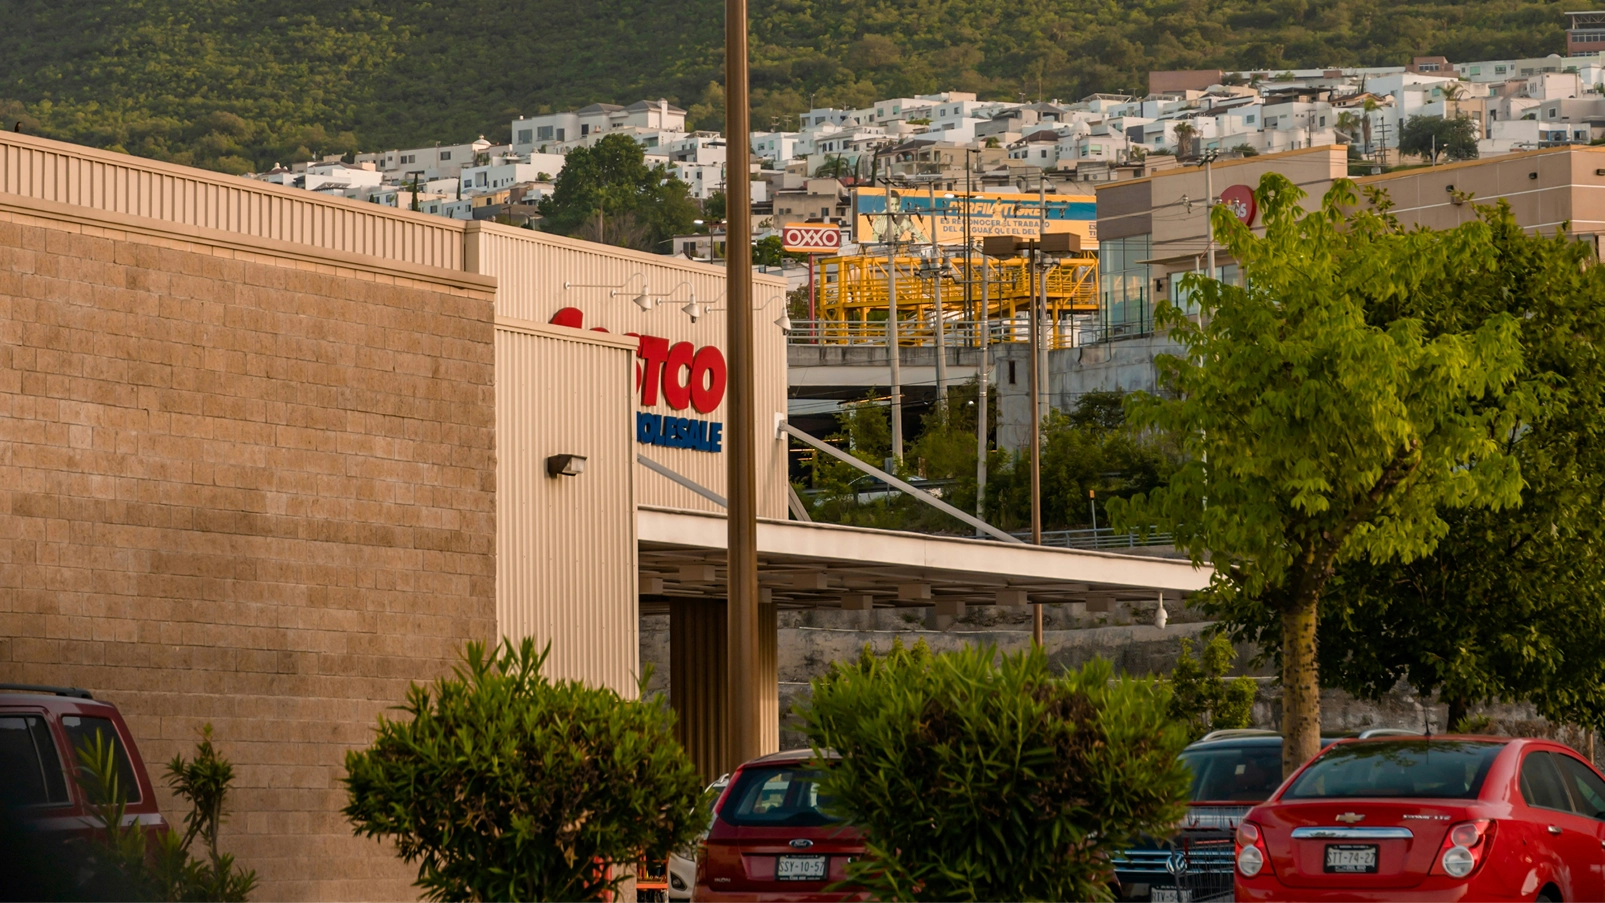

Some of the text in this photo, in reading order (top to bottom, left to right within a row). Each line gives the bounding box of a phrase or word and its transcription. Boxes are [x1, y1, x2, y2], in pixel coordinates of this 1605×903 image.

[1013, 220, 1050, 228] TRABAO
[969, 226, 993, 234] GUAL
[1022, 228, 1037, 236] DEL
[786, 229, 838, 246] OXXO
[1327, 851, 1376, 864] STT-74-27
[779, 861, 825, 872] SSY-10-57
